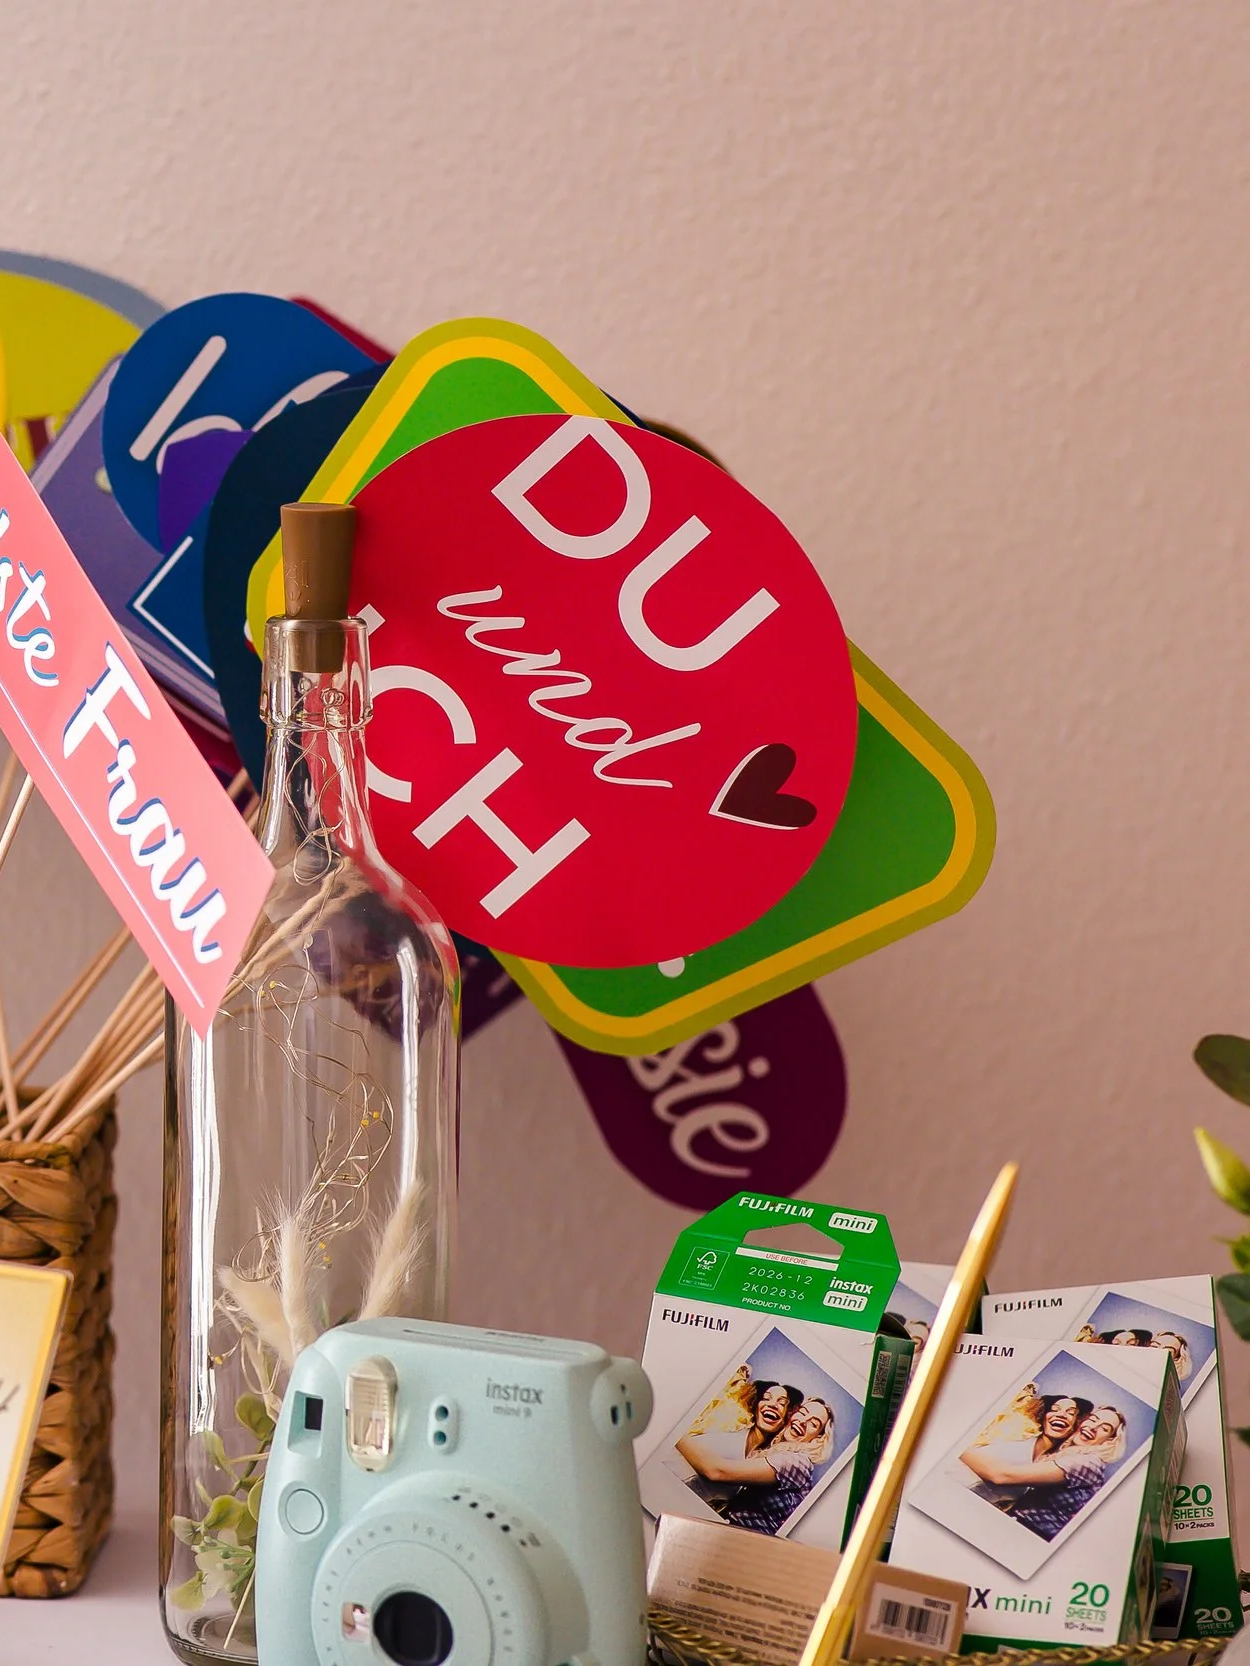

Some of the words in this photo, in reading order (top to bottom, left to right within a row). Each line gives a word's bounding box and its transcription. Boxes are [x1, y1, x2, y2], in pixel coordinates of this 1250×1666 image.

[490, 414, 780, 672] DU
[437, 585, 702, 789] und
[356, 604, 591, 920] CH
[62, 640, 228, 964] Frau
[739, 1197, 814, 1218] FUJIFILM
[833, 1215, 874, 1231] mini
[765, 1253, 780, 1262] USE
[781, 1255, 808, 1266] BEFORE
[742, 1282, 805, 1301] 2K02836
[830, 1276, 873, 1295] instax
[742, 1297, 778, 1310] PRODUCT
[827, 1294, 864, 1309] mini
[994, 1298, 1063, 1313] FUJIFILM
[661, 1308, 730, 1332] FUJIFILM
[486, 1377, 545, 1405] instax
[1172, 1484, 1212, 1508] 20
[1173, 1506, 1213, 1521] SHEETS
[1069, 1581, 1110, 1608] 20
[995, 1594, 1052, 1615] mini
[1066, 1606, 1107, 1622] SHEETS
[1194, 1606, 1232, 1624] 20
[1196, 1621, 1235, 1632] SHEETS
